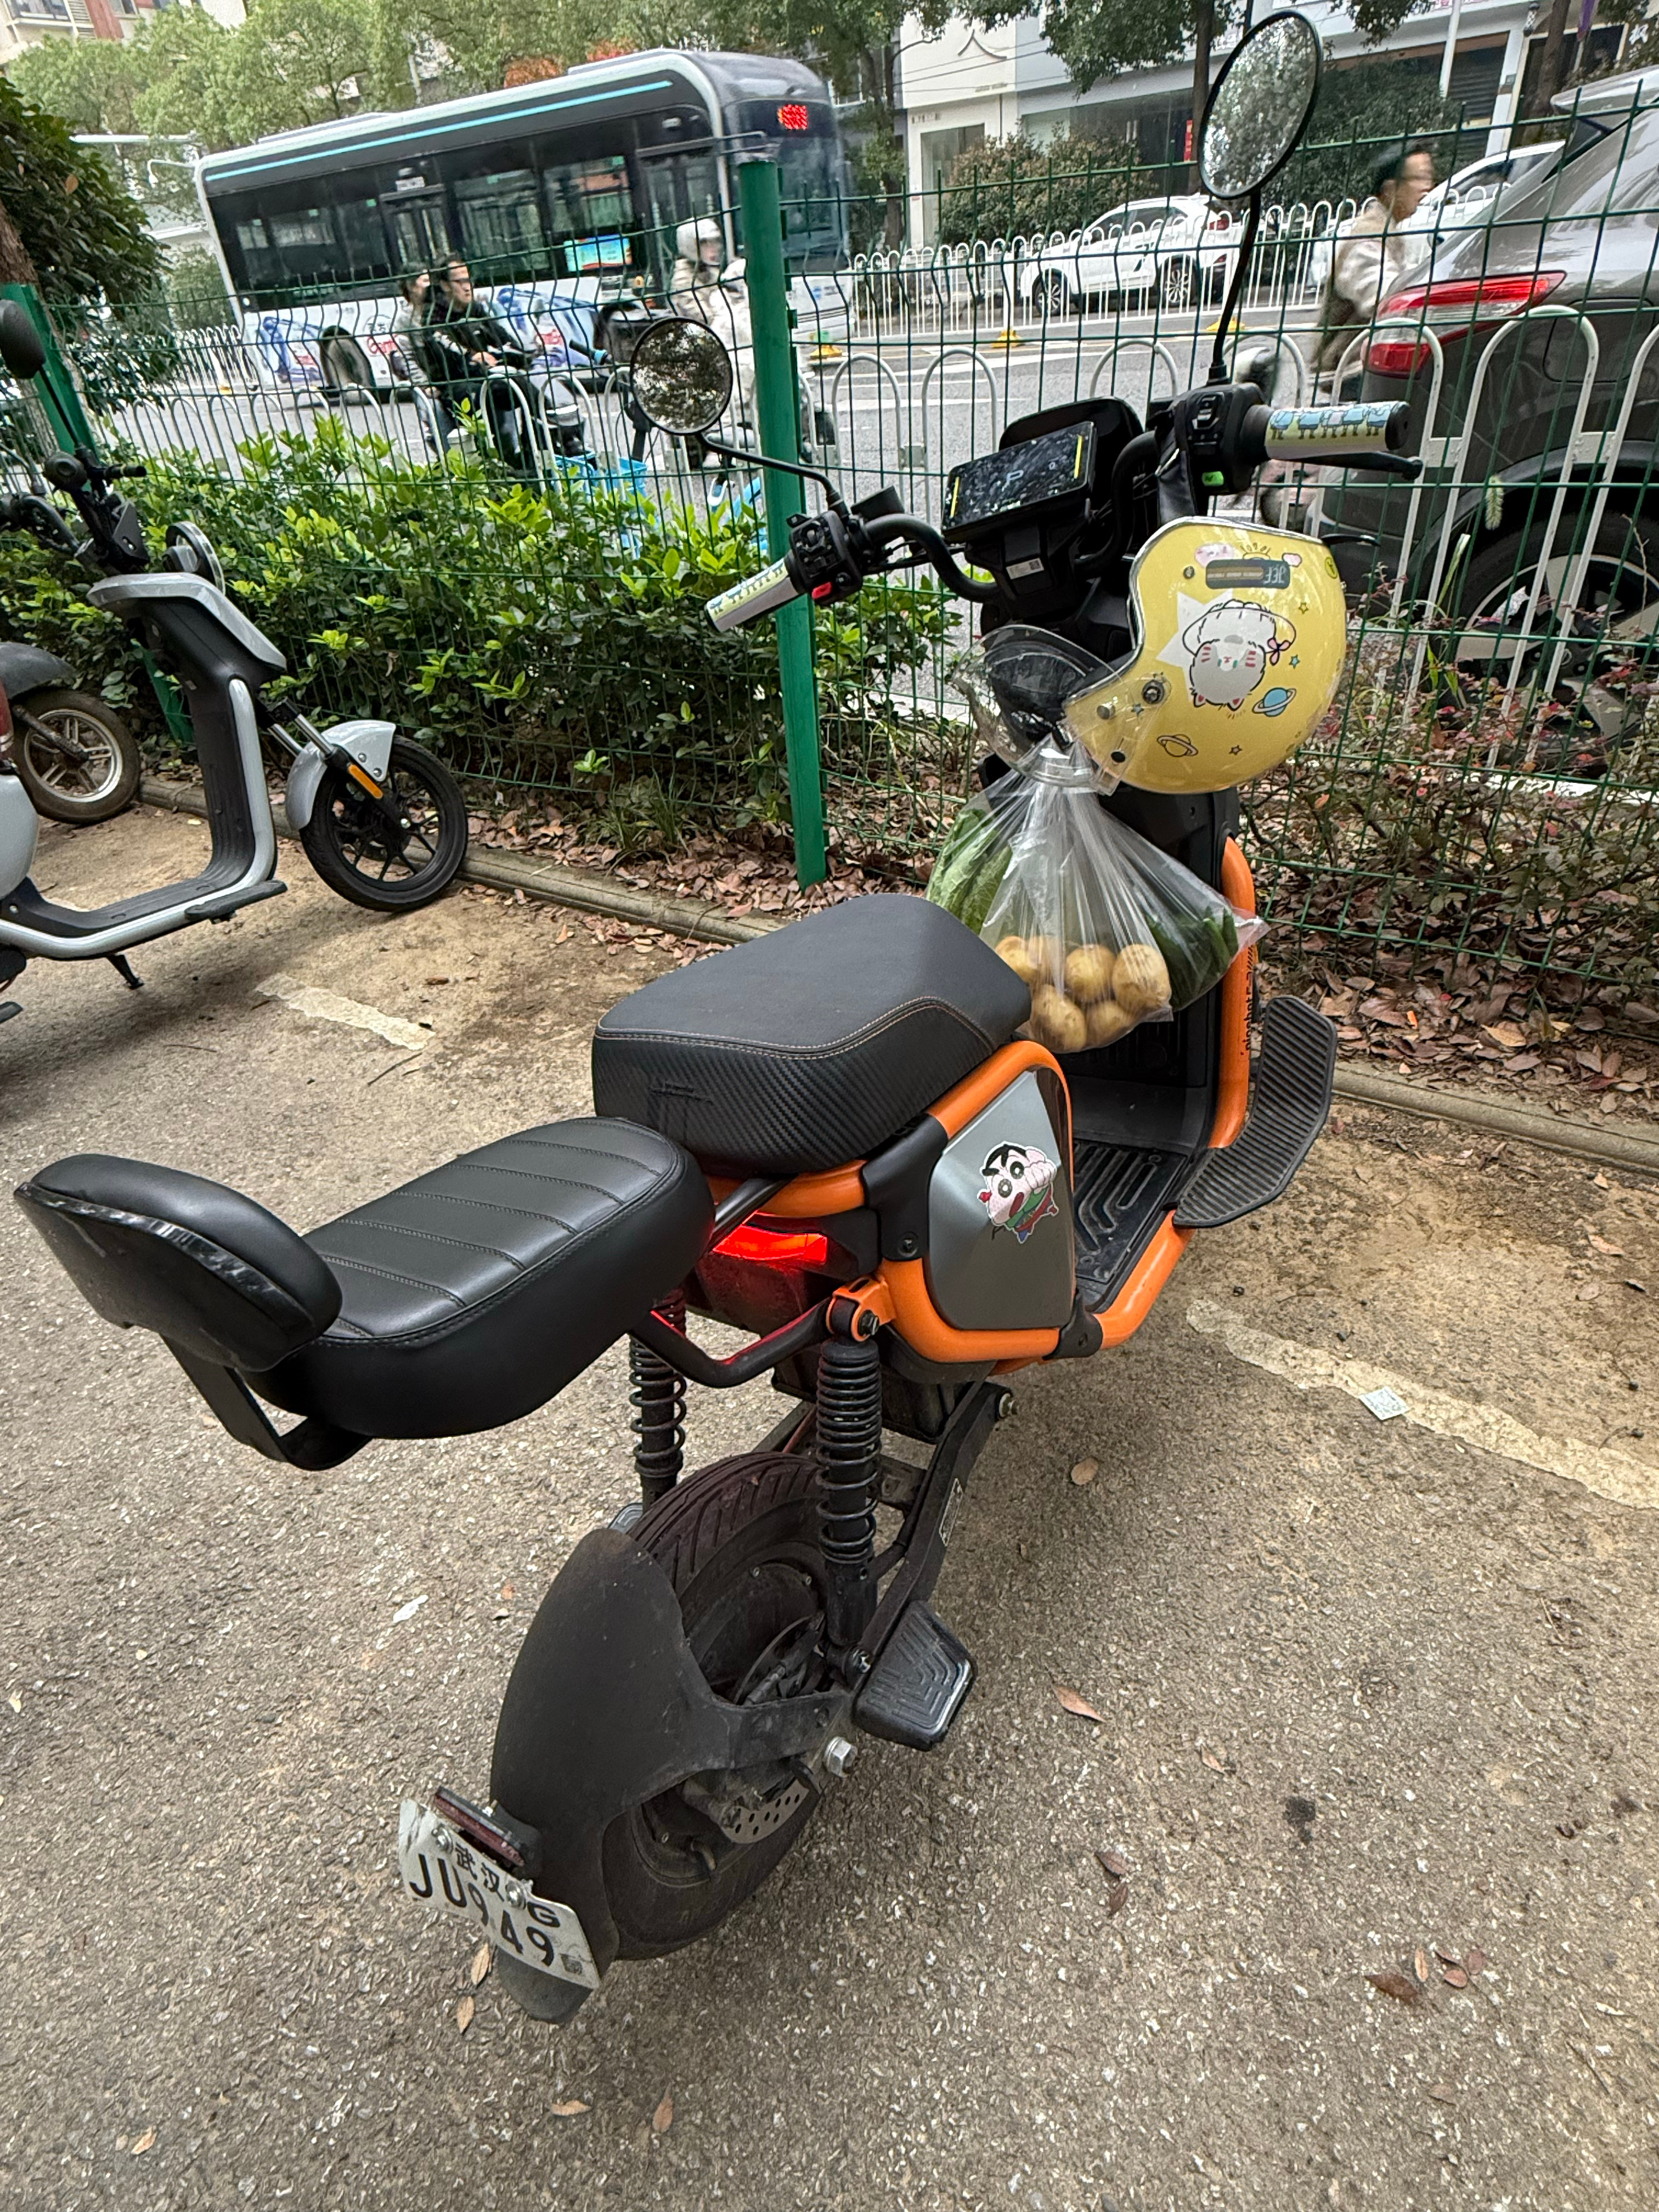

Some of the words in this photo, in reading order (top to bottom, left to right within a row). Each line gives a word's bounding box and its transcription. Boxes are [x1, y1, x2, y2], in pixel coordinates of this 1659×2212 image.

[1005, 469, 1024, 490] P
[409, 1852, 556, 1967] JU949
[455, 1842, 505, 1903] 武汉
[527, 1901, 561, 1928] G
